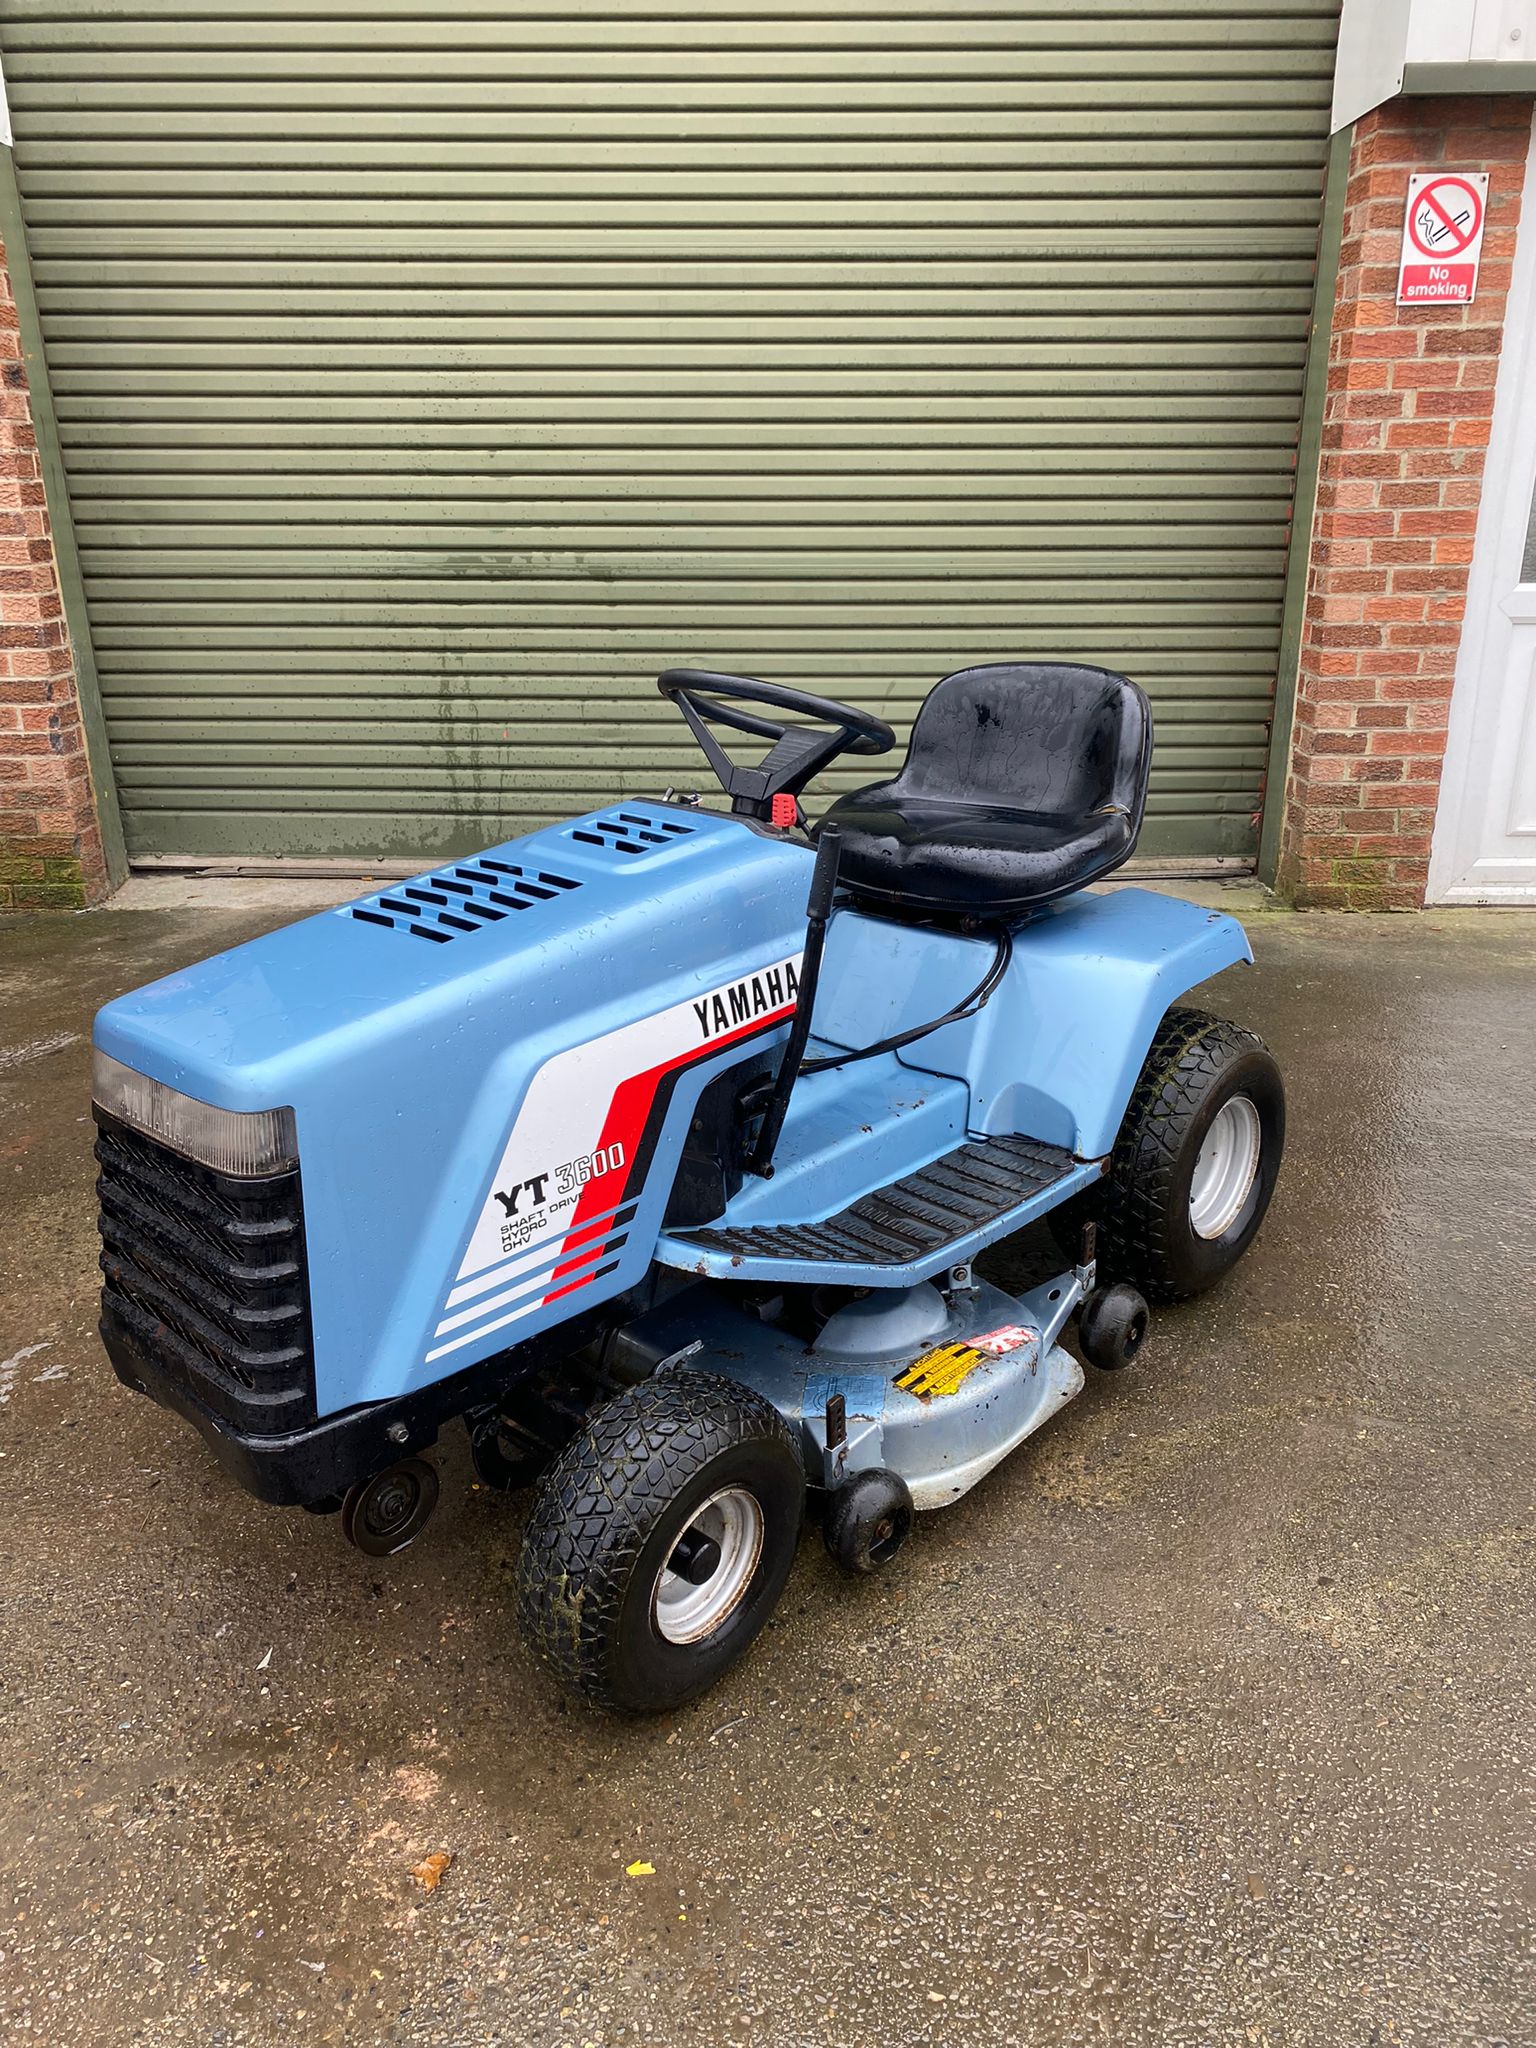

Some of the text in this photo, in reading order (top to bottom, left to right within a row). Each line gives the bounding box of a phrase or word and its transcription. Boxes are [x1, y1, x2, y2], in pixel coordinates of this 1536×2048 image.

[1429, 267, 1449, 280] No
[1407, 282, 1467, 298] smoking
[693, 962, 799, 1039] YAMAHA
[494, 1141, 625, 1218] YT 3600
[500, 1192, 585, 1235] SHAFT DRIVE
[501, 1218, 547, 1244] HYDRO
[503, 1234, 531, 1253] OHV
